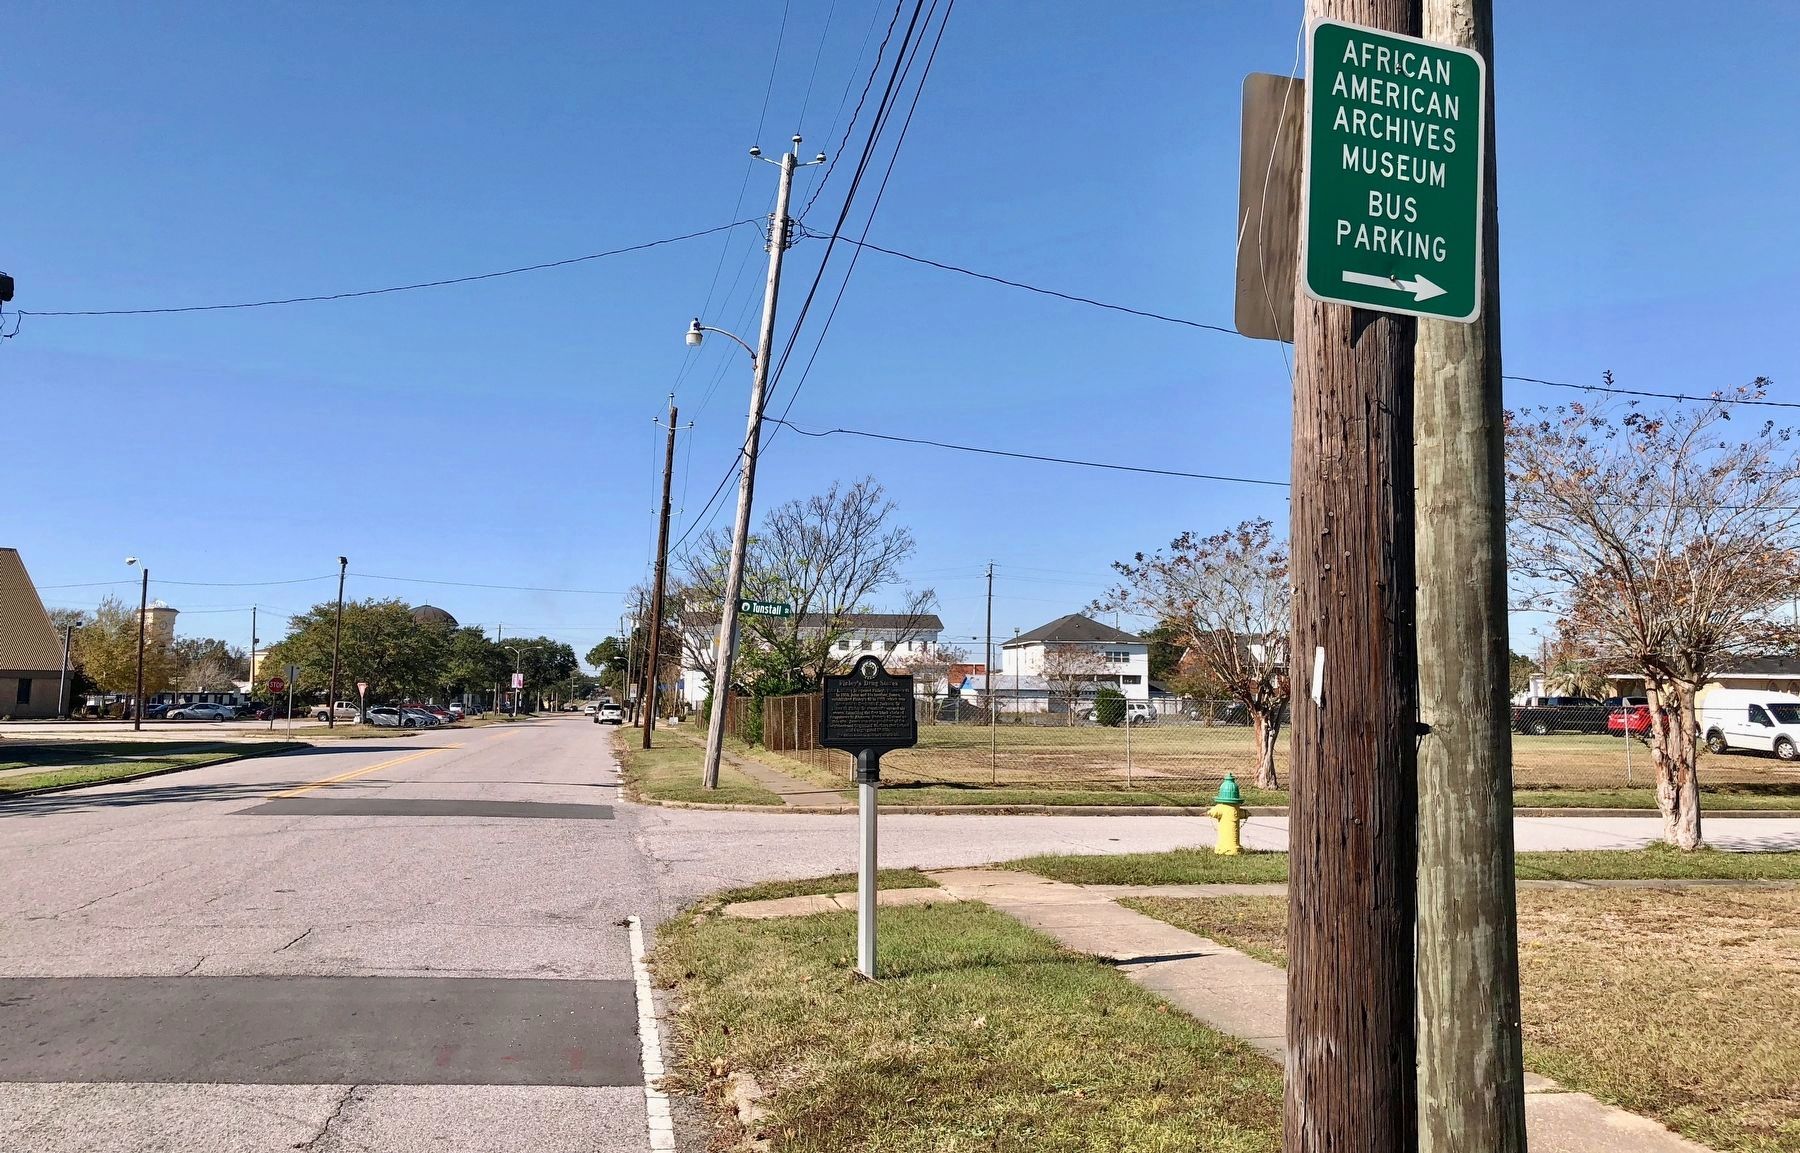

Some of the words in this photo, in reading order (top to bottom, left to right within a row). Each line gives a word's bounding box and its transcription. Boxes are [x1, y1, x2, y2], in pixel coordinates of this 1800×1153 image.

[1342, 39, 1451, 86] AFRICAN
[1331, 71, 1460, 121] AMERICAN
[1333, 105, 1457, 154] ARCHIVES
[1342, 143, 1446, 189] MUSEUM
[1368, 190, 1418, 223] BUS
[1336, 219, 1447, 263] PARKING
[752, 602, 782, 615] Tunstall
